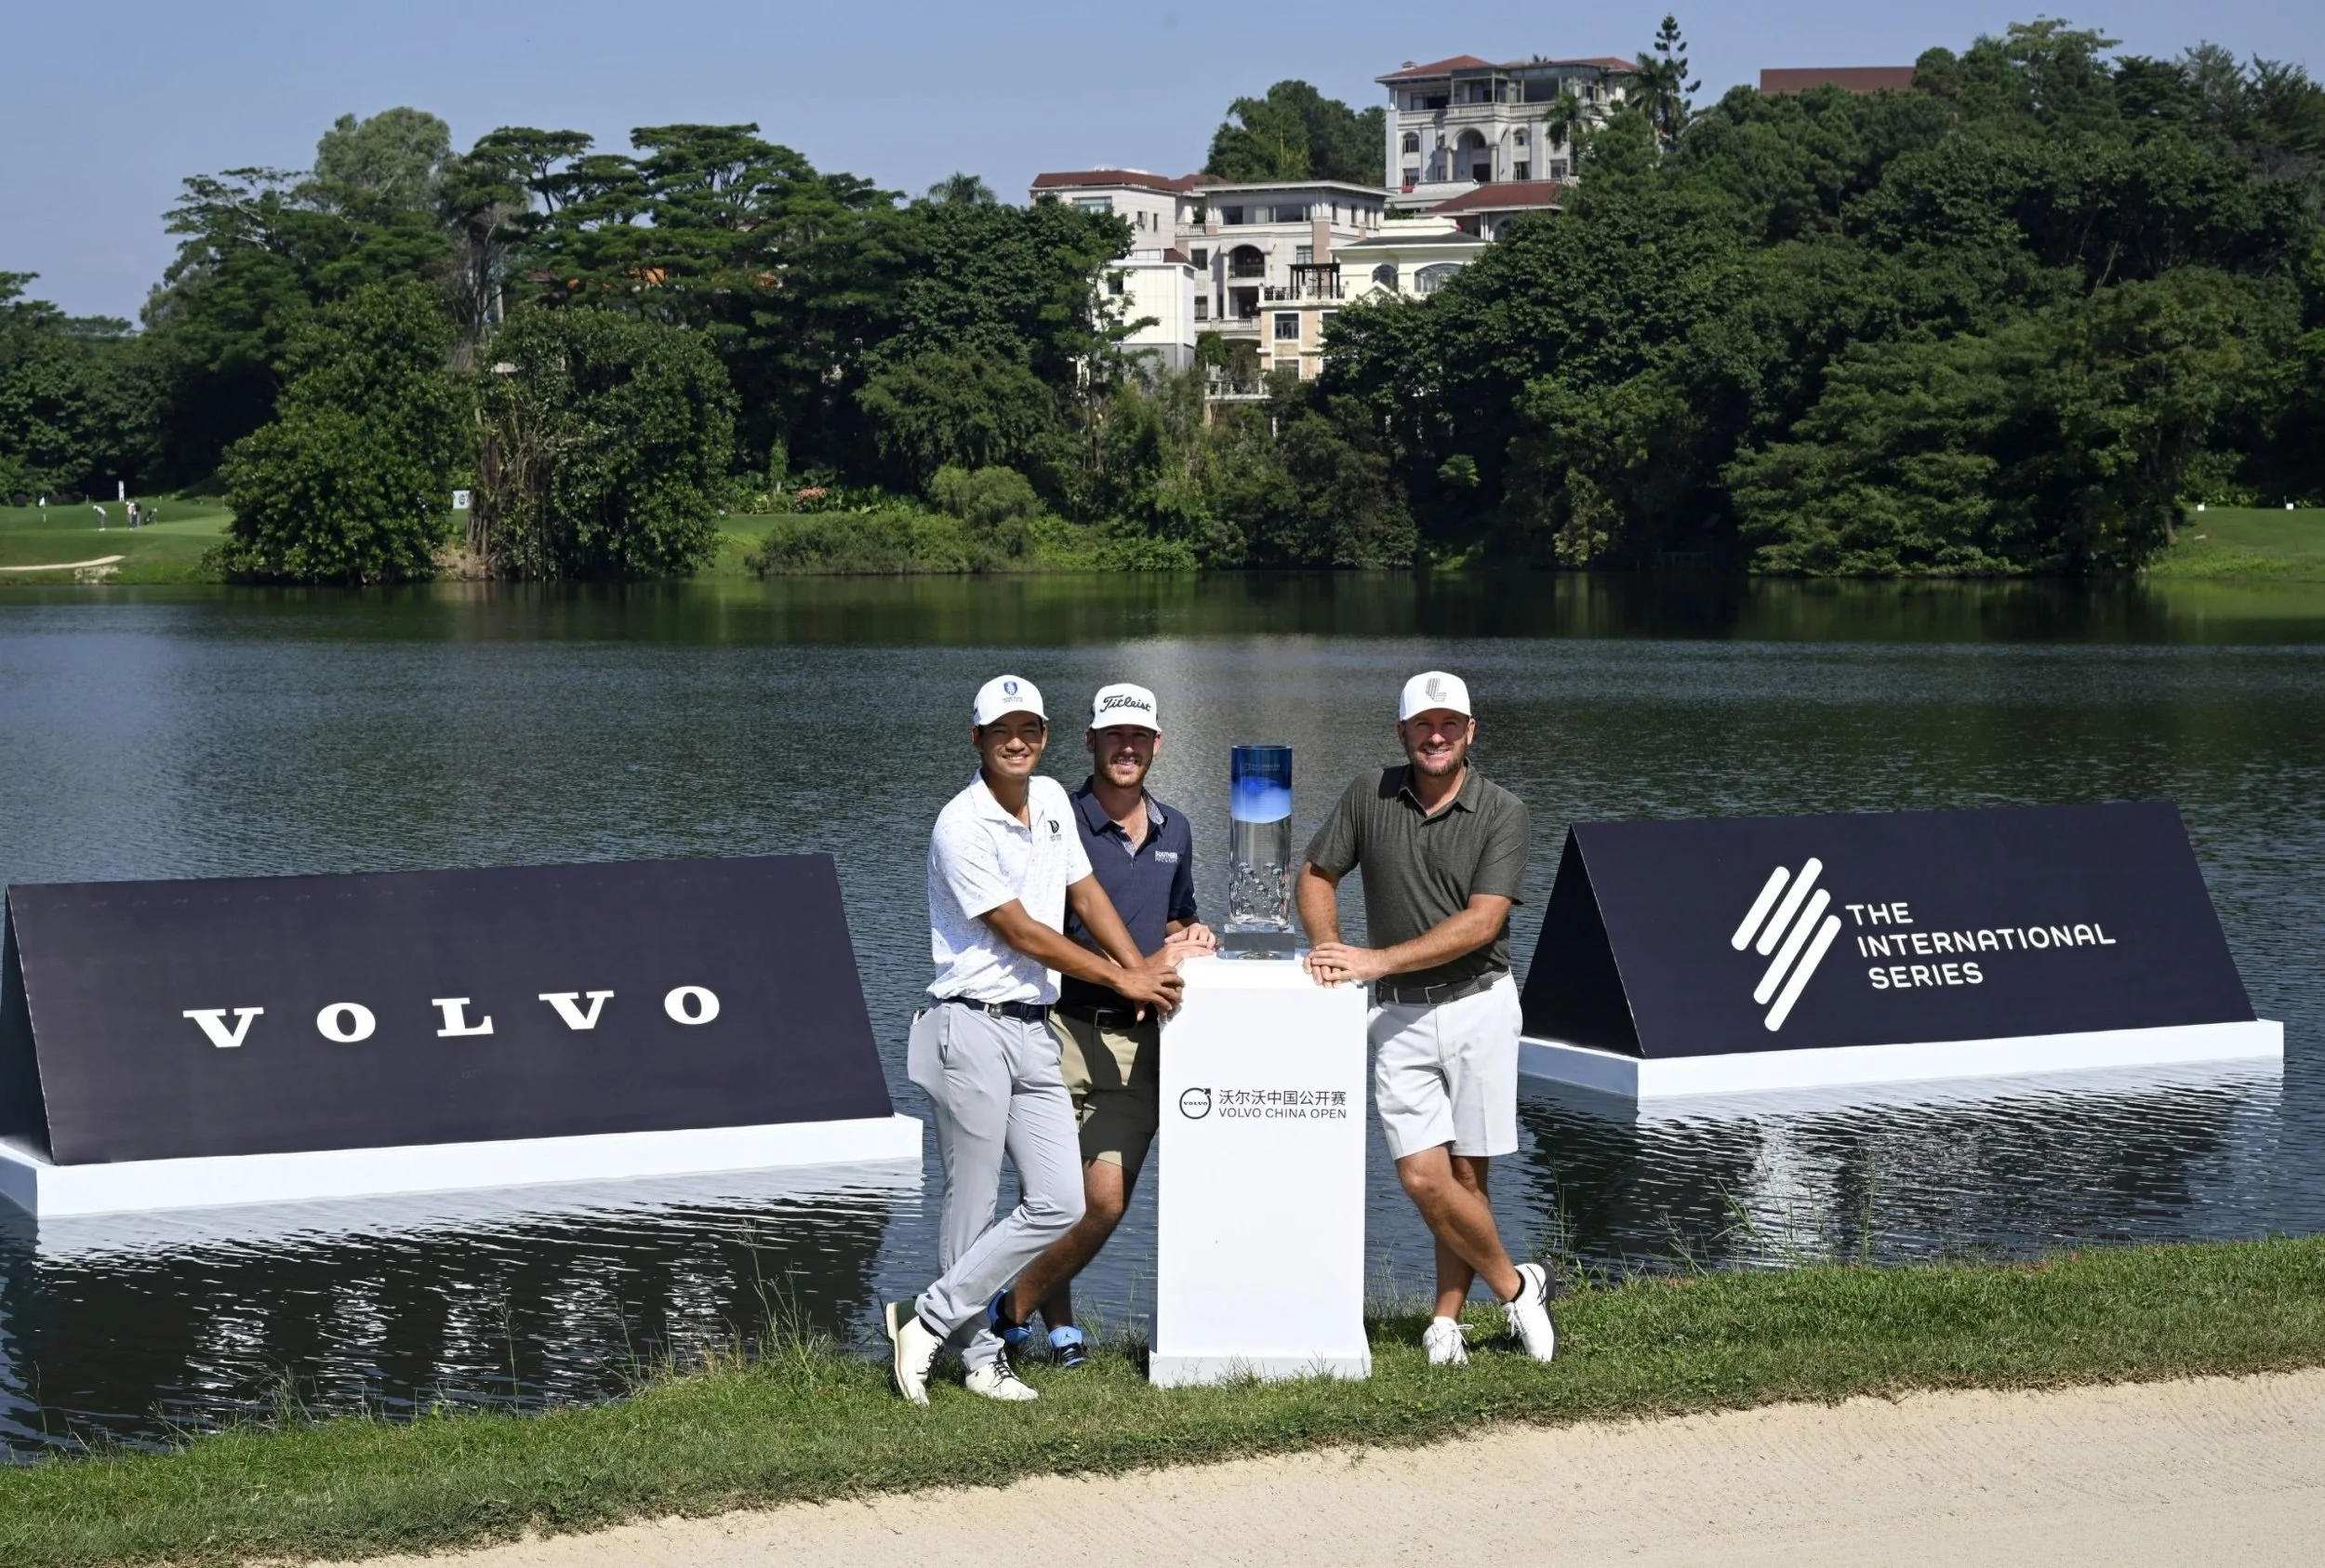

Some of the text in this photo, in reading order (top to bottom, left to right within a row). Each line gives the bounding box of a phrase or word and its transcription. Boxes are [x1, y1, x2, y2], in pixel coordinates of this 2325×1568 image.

[1099, 695, 1151, 713] Titleist
[1845, 902, 1914, 926] THE
[1857, 924, 2117, 958] INTERNATIONAL
[1868, 962, 1984, 990] SERIES
[182, 985, 720, 1048] VOLVO
[1219, 1089, 1347, 1106] 沃尔沃中国公开赛
[1218, 1108, 1347, 1119] VOLVO CHINA OPEN
